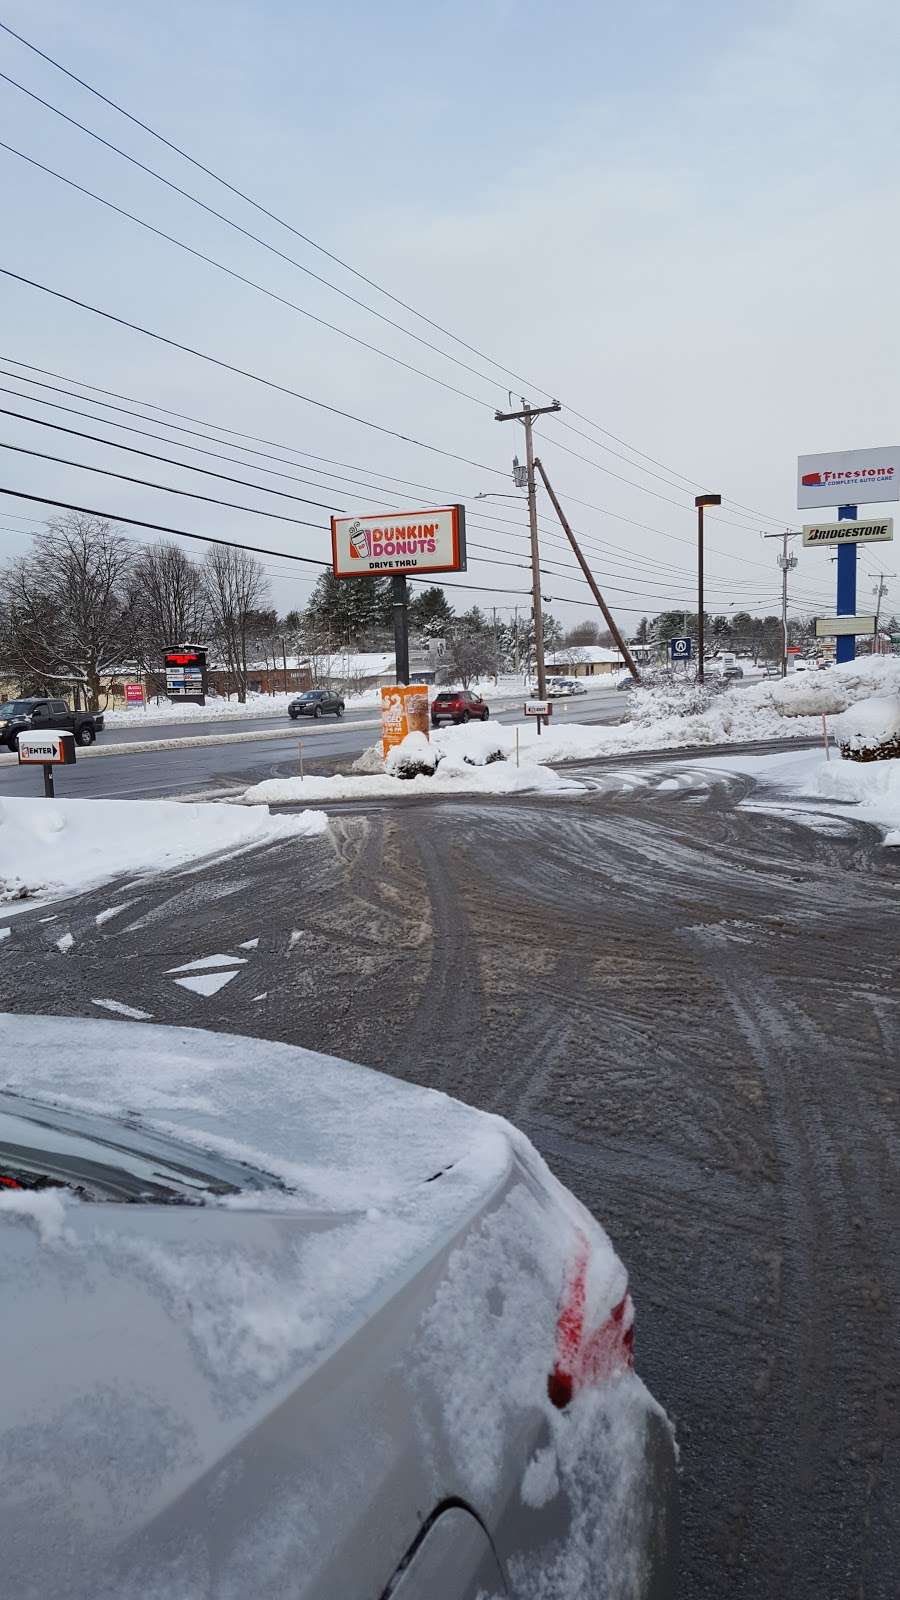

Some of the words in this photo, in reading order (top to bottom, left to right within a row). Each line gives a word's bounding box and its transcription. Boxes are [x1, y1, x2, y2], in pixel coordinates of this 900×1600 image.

[823, 467, 895, 481] Firestone
[372, 523, 439, 542] DUNKIN'
[808, 525, 888, 541] BRIDGESTONE
[372, 538, 437, 556] DONUTS
[369, 561, 394, 569] DRIVE
[395, 559, 417, 567] THRU
